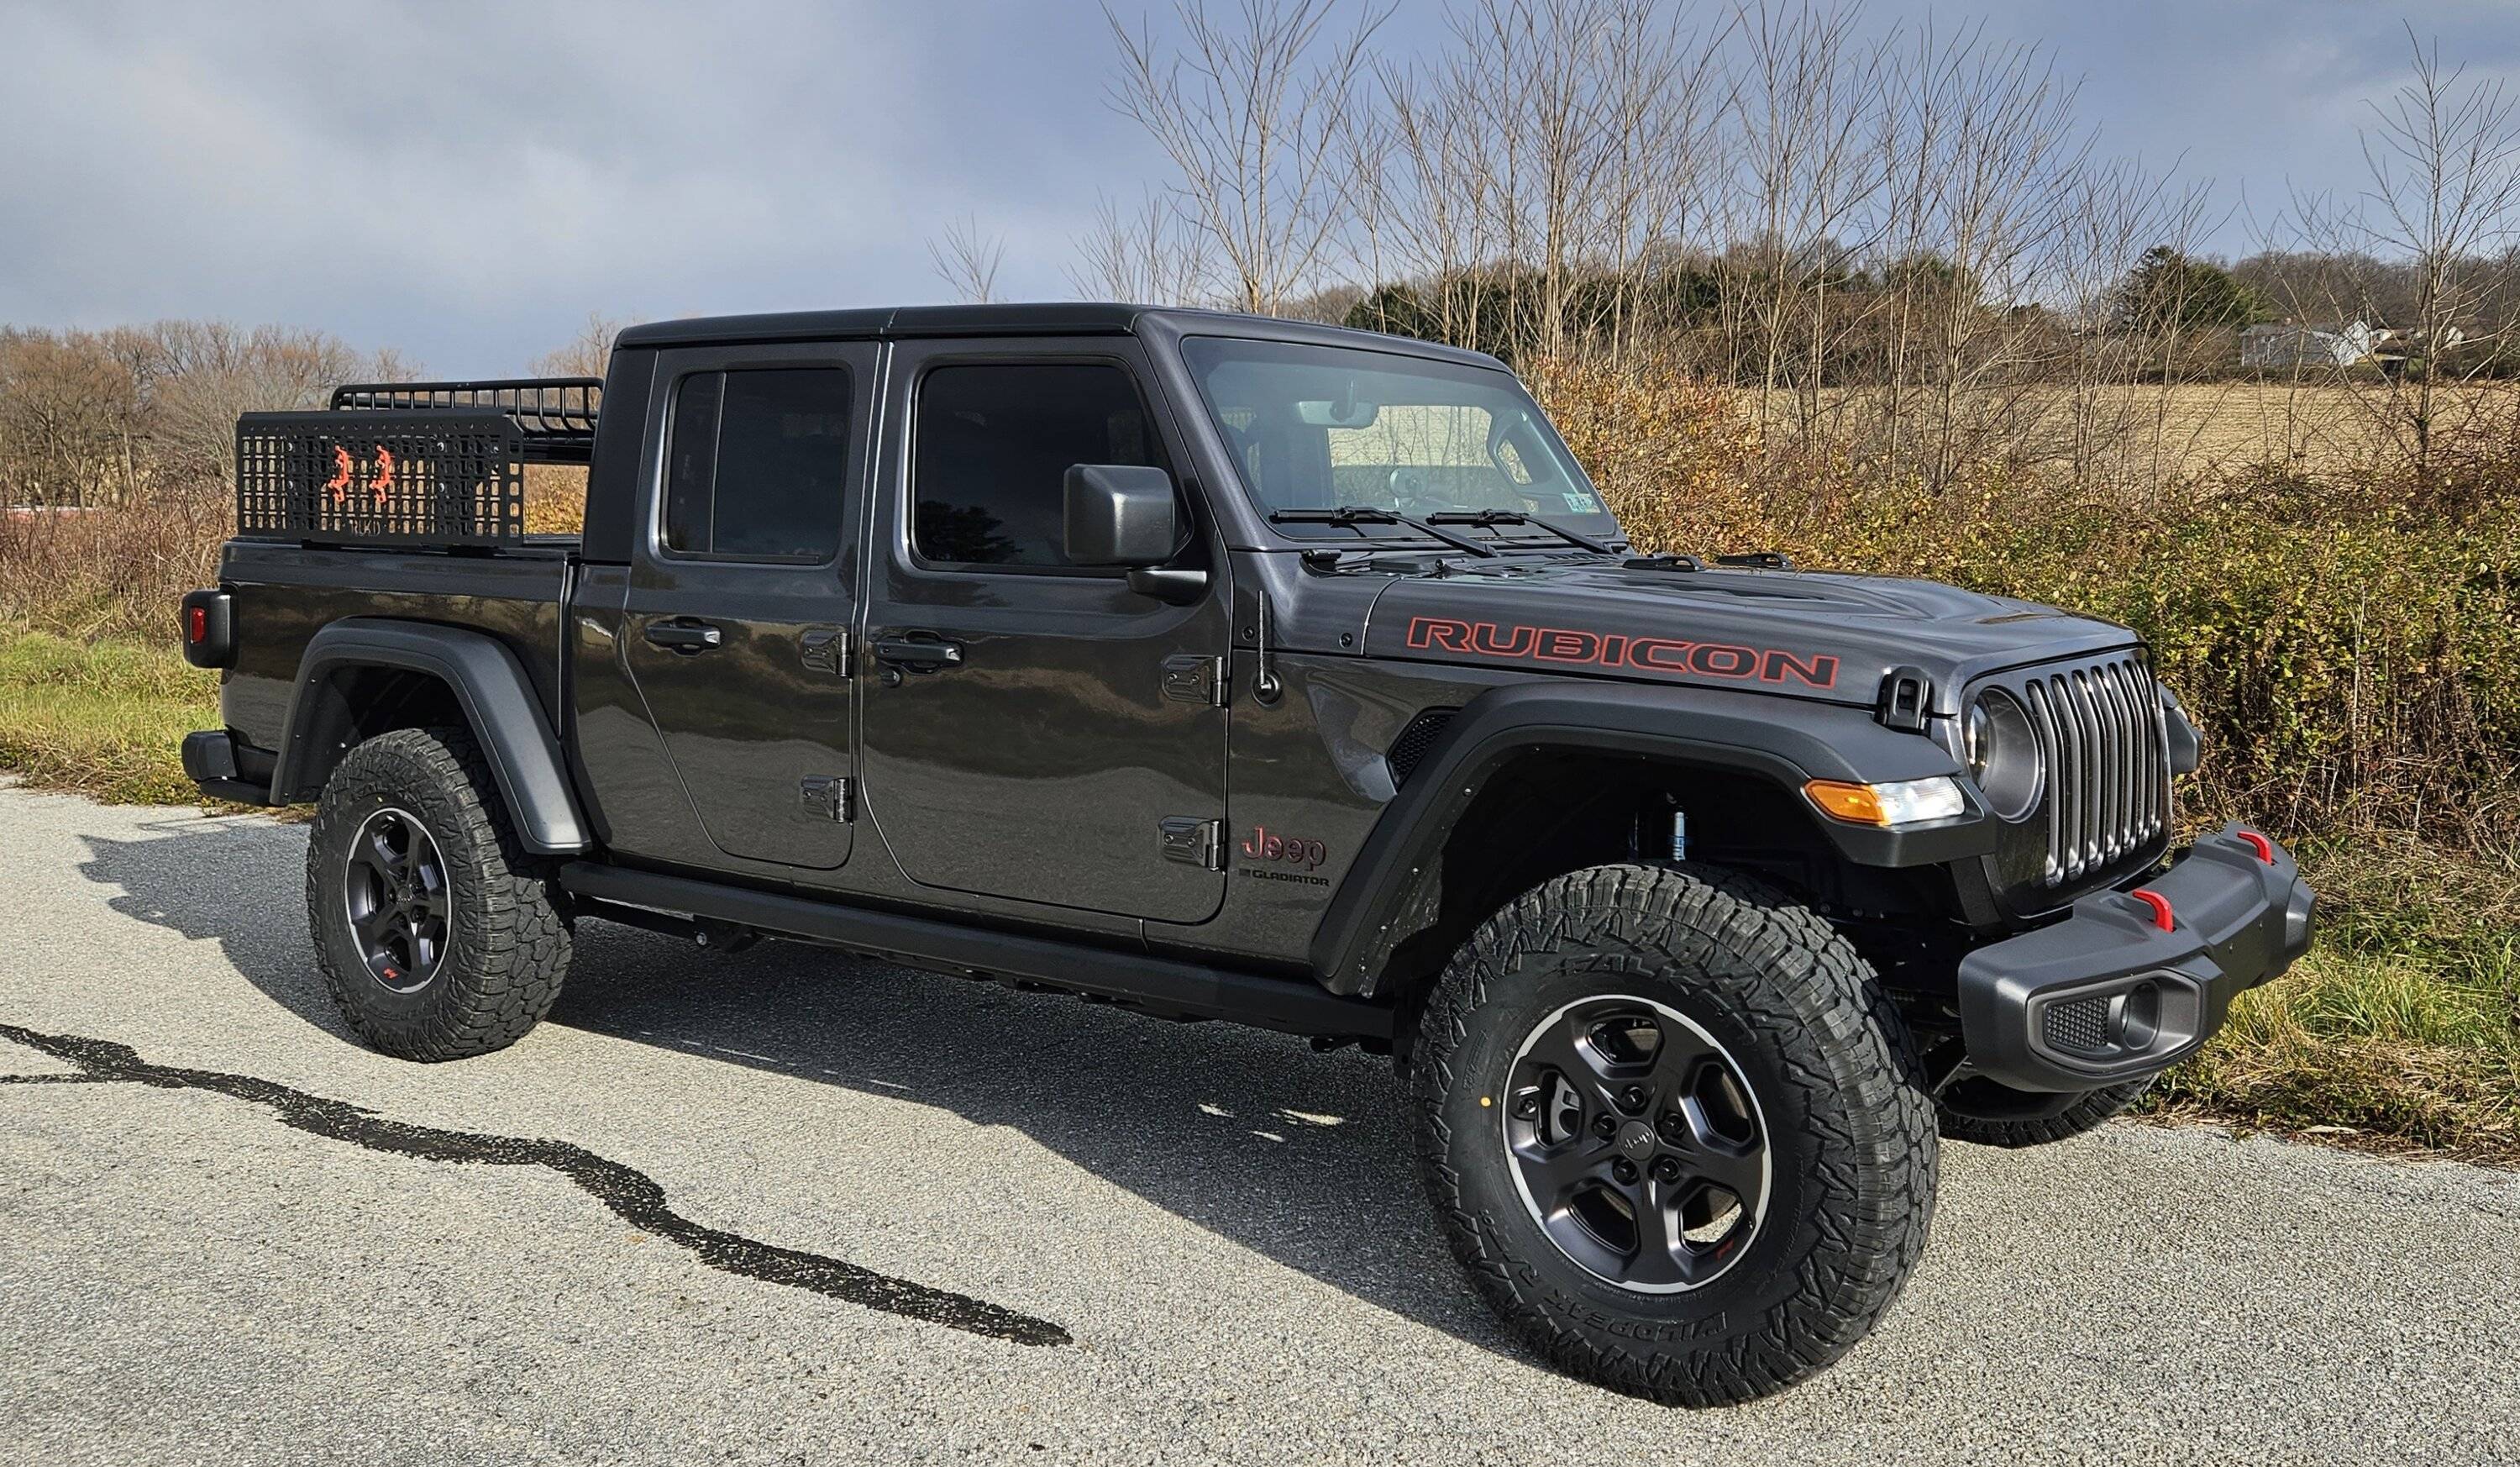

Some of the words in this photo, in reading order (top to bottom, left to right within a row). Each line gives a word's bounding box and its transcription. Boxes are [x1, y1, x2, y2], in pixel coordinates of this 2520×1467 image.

[1407, 617, 1839, 689] RUBICON
[1242, 826, 1326, 871] Jeep
[1252, 870, 1330, 886] GLADIATOR
